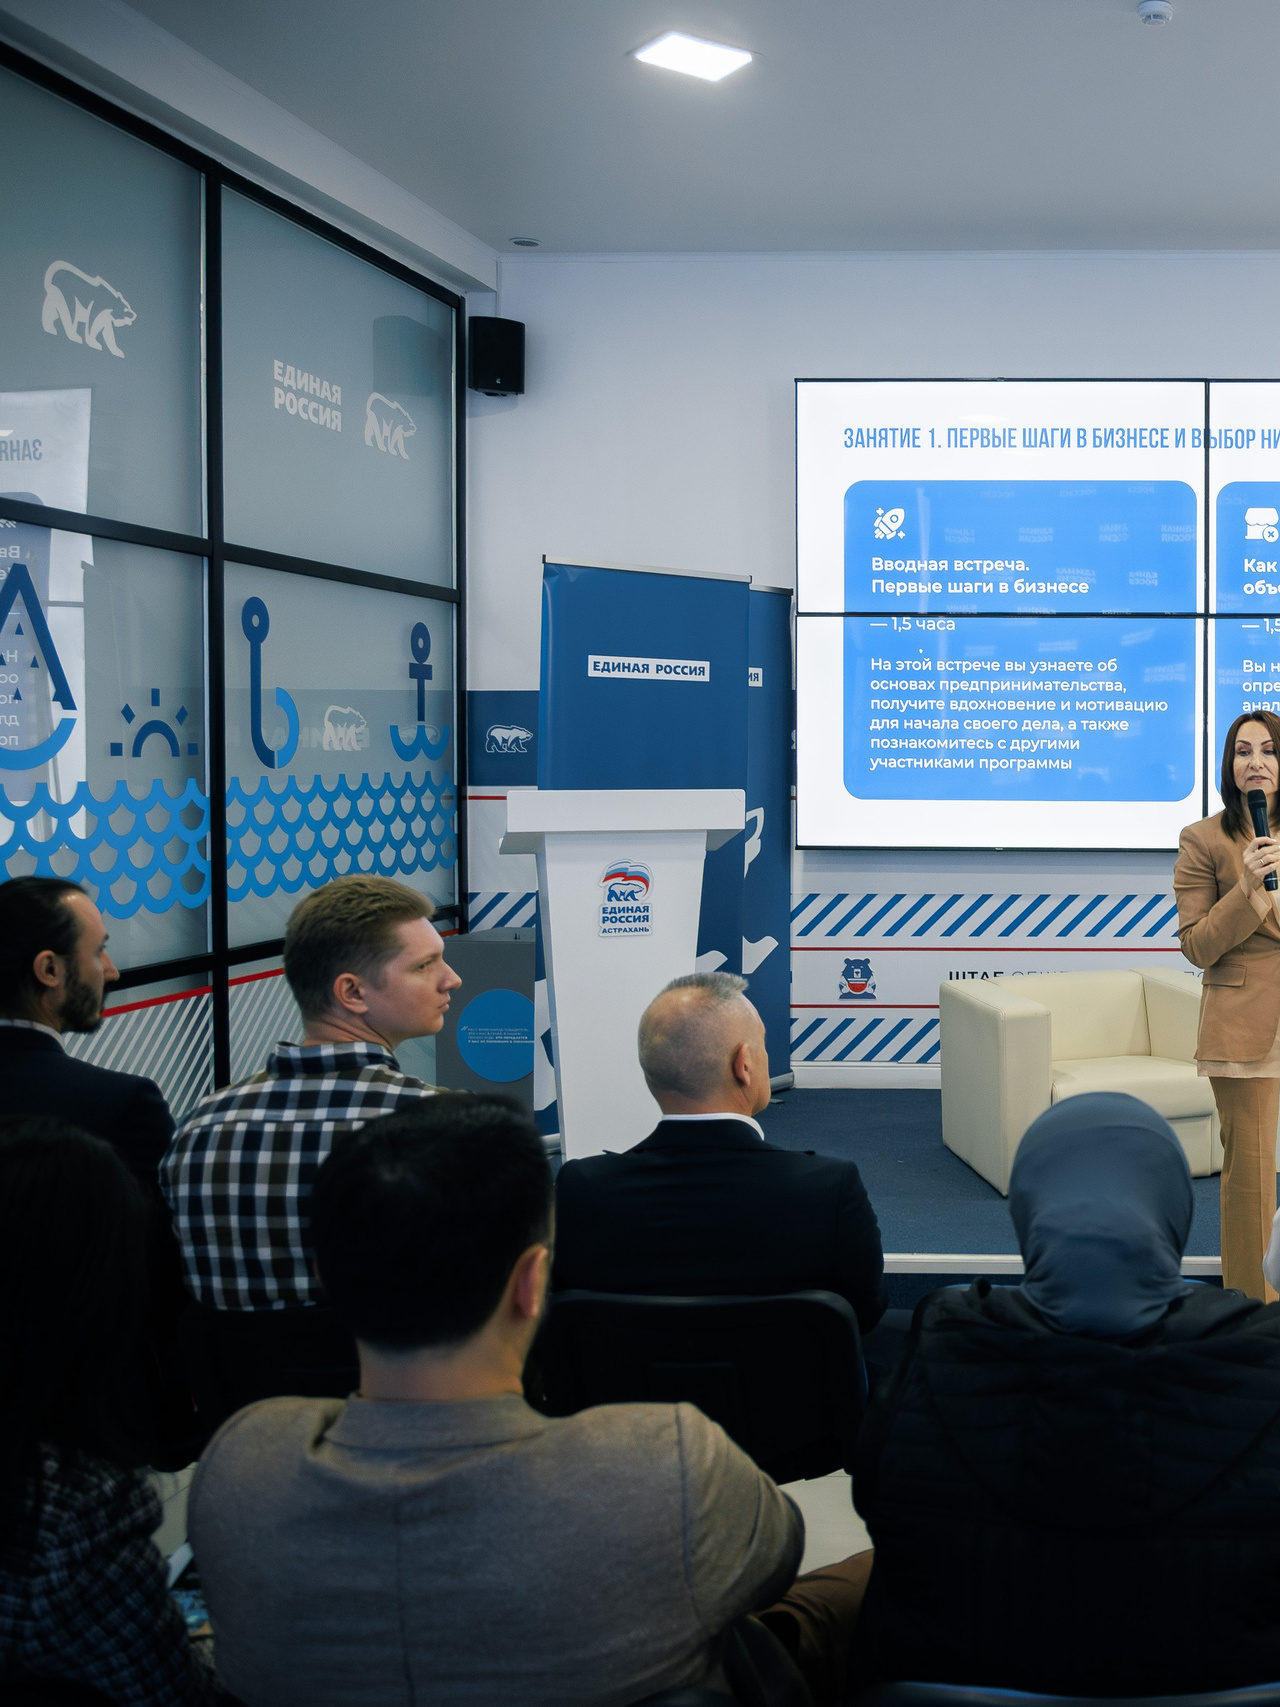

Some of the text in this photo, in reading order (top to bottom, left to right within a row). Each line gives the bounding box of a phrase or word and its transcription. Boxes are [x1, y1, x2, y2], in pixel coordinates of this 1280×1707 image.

[273, 359, 342, 406] ЕДИНАЯ
[274, 386, 342, 432] РОССИЯ
[844, 428, 920, 448] ЗАНЯТИЕ
[929, 428, 941, 448] 1.
[948, 428, 1016, 448] ПЕРВЫЕ
[1023, 428, 1070, 448] ШАГИ
[1077, 428, 1087, 448] В
[1093, 428, 1169, 448] БИЗНЕСЕ
[1175, 428, 1185, 448] И
[1191, 428, 1256, 449] ВЫБОР
[871, 557, 1030, 575] Вводная встреча.
[1244, 558, 1278, 573] Как
[872, 578, 1090, 597] Первые шаги в бизнесе
[891, 617, 912, 633] 1,5
[915, 619, 956, 631] часа
[594, 661, 705, 676] ЕДИНАЯ РОССИЯ
[871, 657, 1118, 675] На этой встрече вы узнаете об
[1243, 659, 1266, 673] Вы
[870, 679, 1127, 694] основах предпринимательства,
[870, 699, 1168, 713] получите вдохновение и мотивацию
[869, 718, 1130, 733] для начала своего дела, а также
[870, 738, 1080, 753] познакомитесь с другими
[869, 757, 1072, 772] участниками программы
[602, 906, 649, 914] ЕДИНАЯ
[602, 915, 649, 924] РОССИЯ
